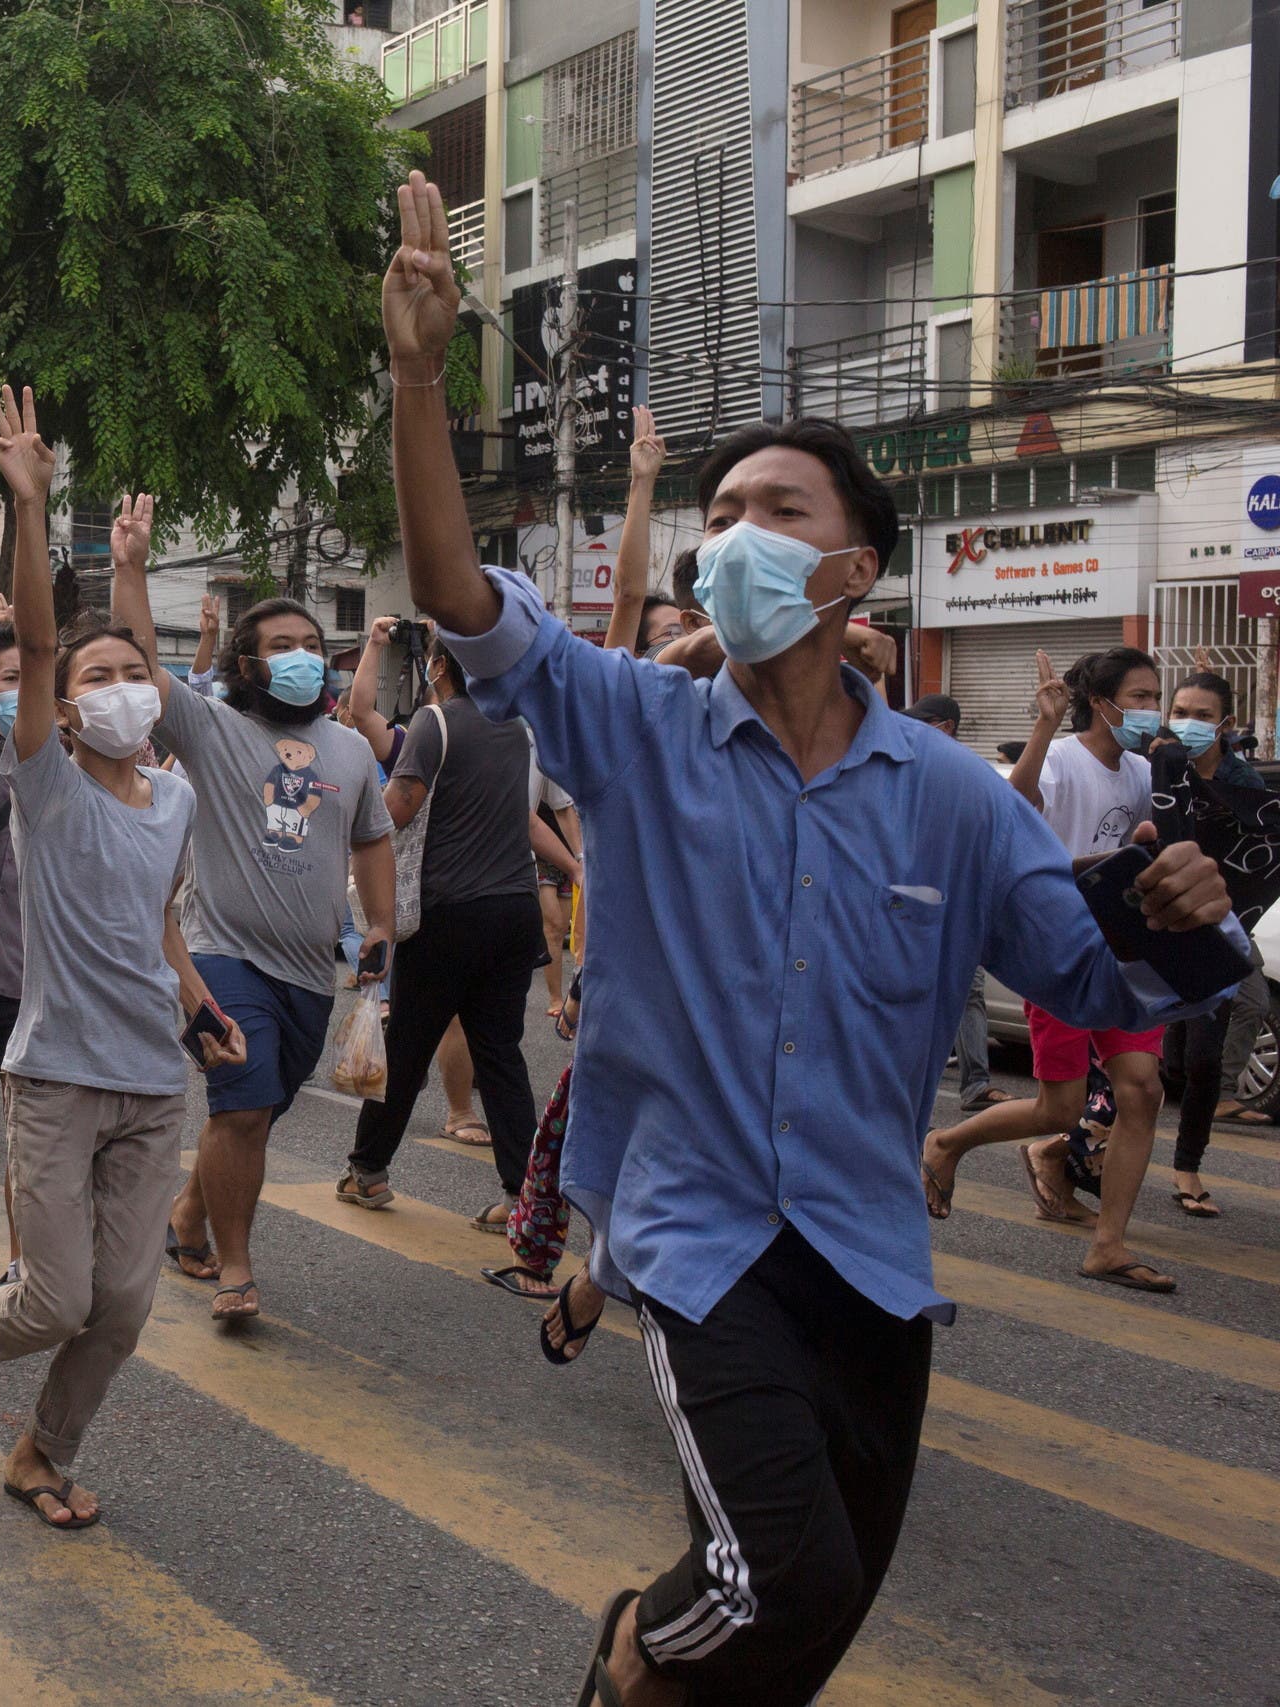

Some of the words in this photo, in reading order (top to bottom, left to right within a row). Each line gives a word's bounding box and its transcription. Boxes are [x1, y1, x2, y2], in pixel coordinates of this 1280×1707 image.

[518, 421, 547, 439] Apple
[547, 407, 610, 431] Prssional
[524, 442, 552, 457] Sales
[1248, 493, 1280, 512] KAL
[995, 565, 1035, 580] Software
[1041, 563, 1048, 577] &
[1053, 560, 1083, 575] Games
[1085, 559, 1099, 573] CD
[292, 823, 298, 832] 3
